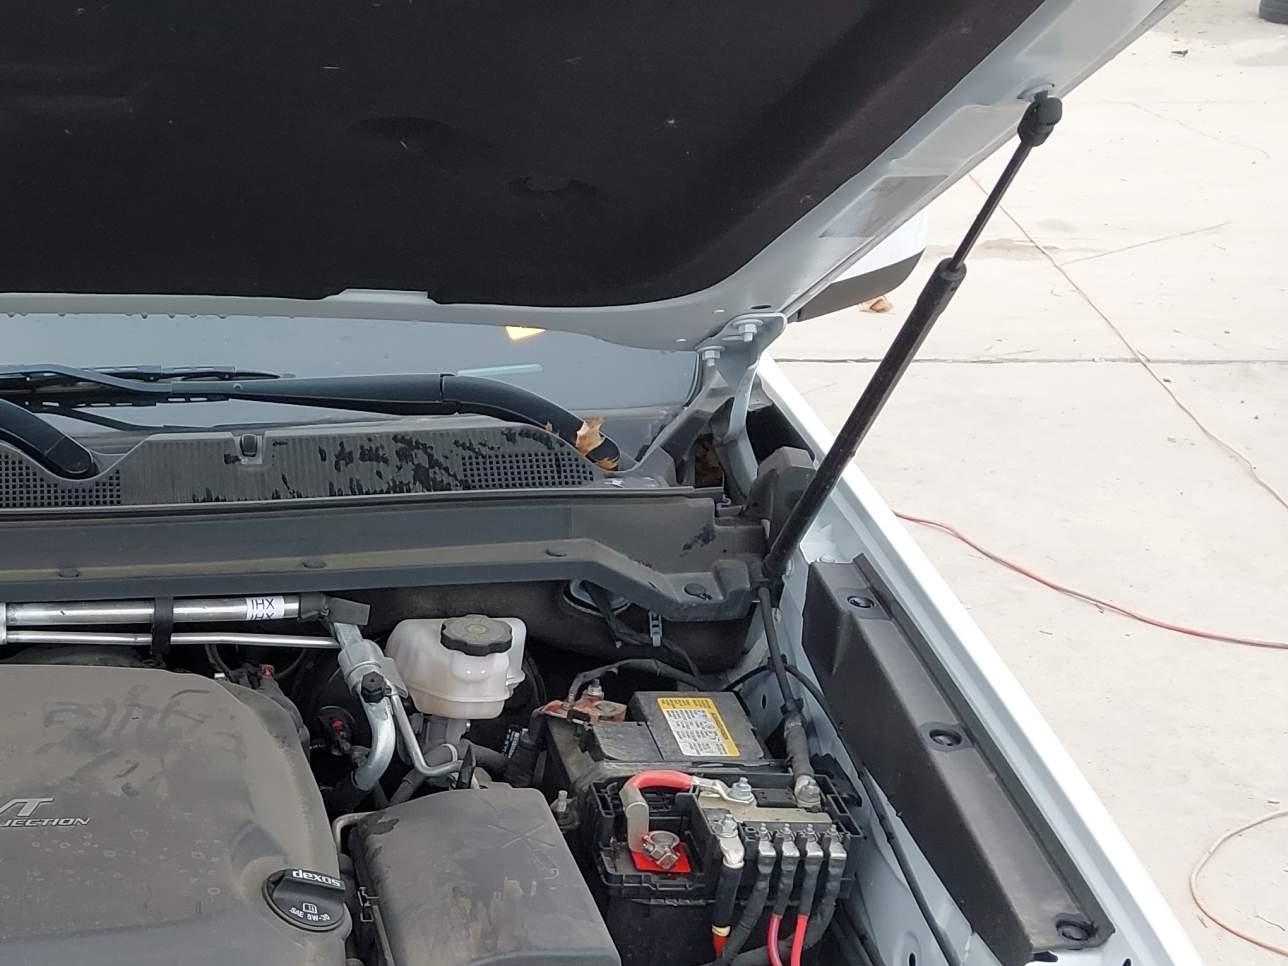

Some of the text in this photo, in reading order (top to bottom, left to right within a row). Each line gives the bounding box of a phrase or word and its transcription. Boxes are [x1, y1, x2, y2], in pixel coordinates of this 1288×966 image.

[251, 598, 275, 610] IHX
[292, 869, 341, 887] dexos
[289, 907, 304, 918] SAE
